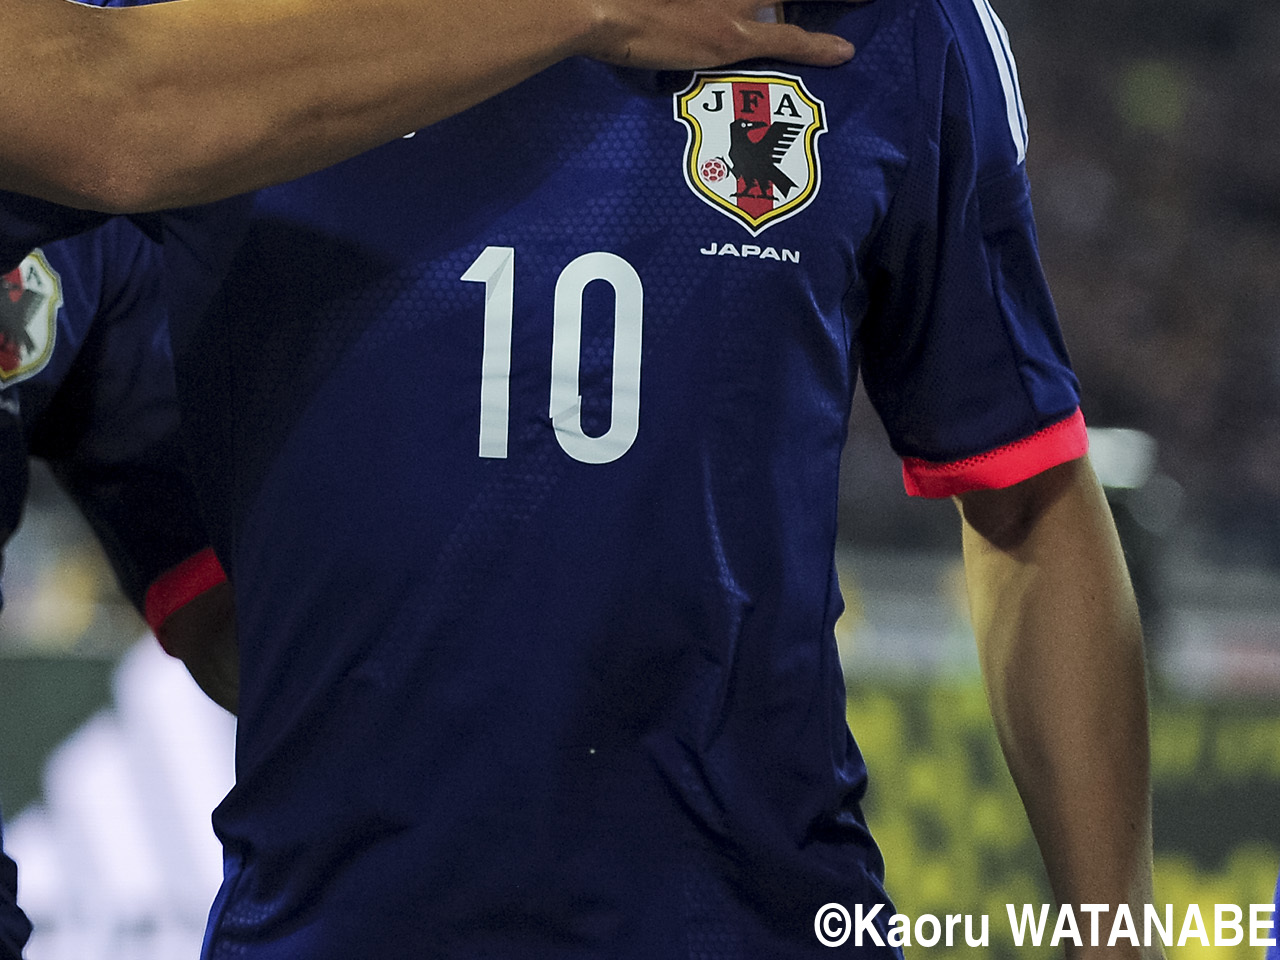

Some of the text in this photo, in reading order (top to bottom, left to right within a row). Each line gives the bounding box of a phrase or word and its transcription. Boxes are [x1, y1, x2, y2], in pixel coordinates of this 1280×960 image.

[702, 89, 802, 118] JFA
[700, 242, 800, 263] JAPAN
[460, 246, 644, 464] 10
